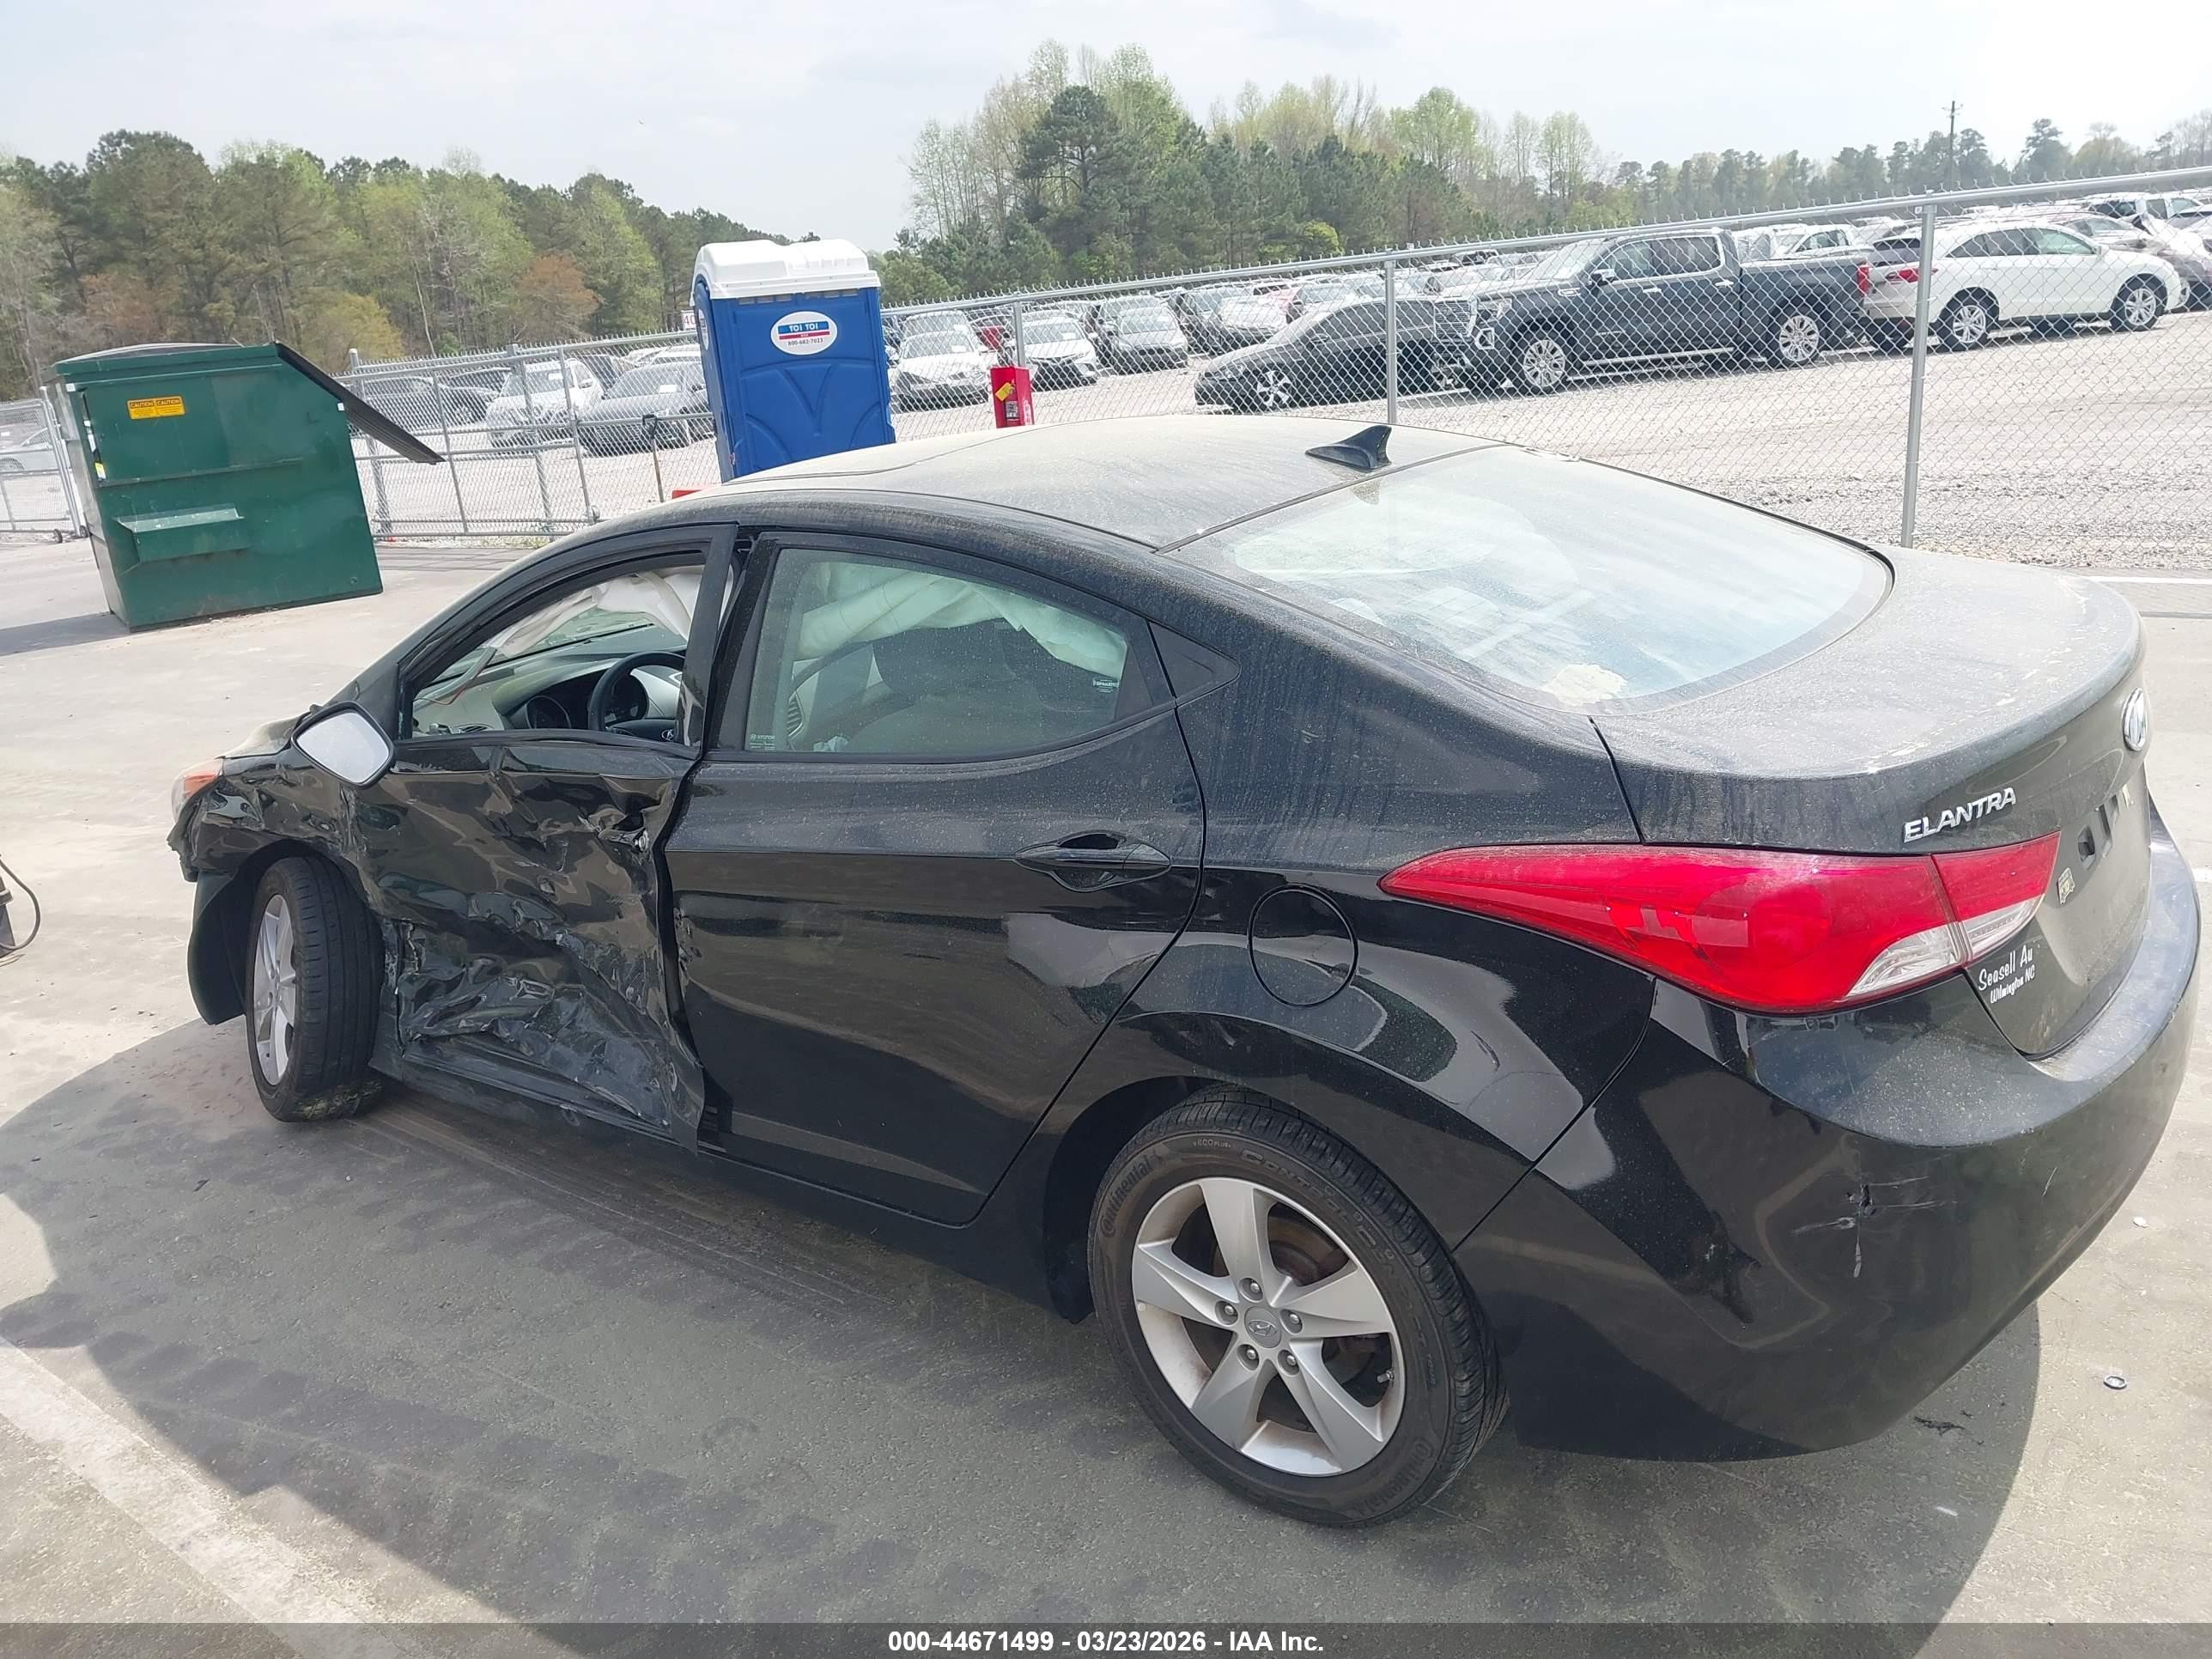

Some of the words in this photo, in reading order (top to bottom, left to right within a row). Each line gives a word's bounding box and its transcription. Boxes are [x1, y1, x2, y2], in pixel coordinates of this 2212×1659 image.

[1904, 787, 2017, 843] ELANTRA
[1978, 950, 2016, 991] Seasell
[2020, 945, 2033, 968] Au
[1990, 976, 2024, 1003] Wilmington
[2025, 963, 2035, 982] NC
[1099, 1155, 1156, 1238] Continental
